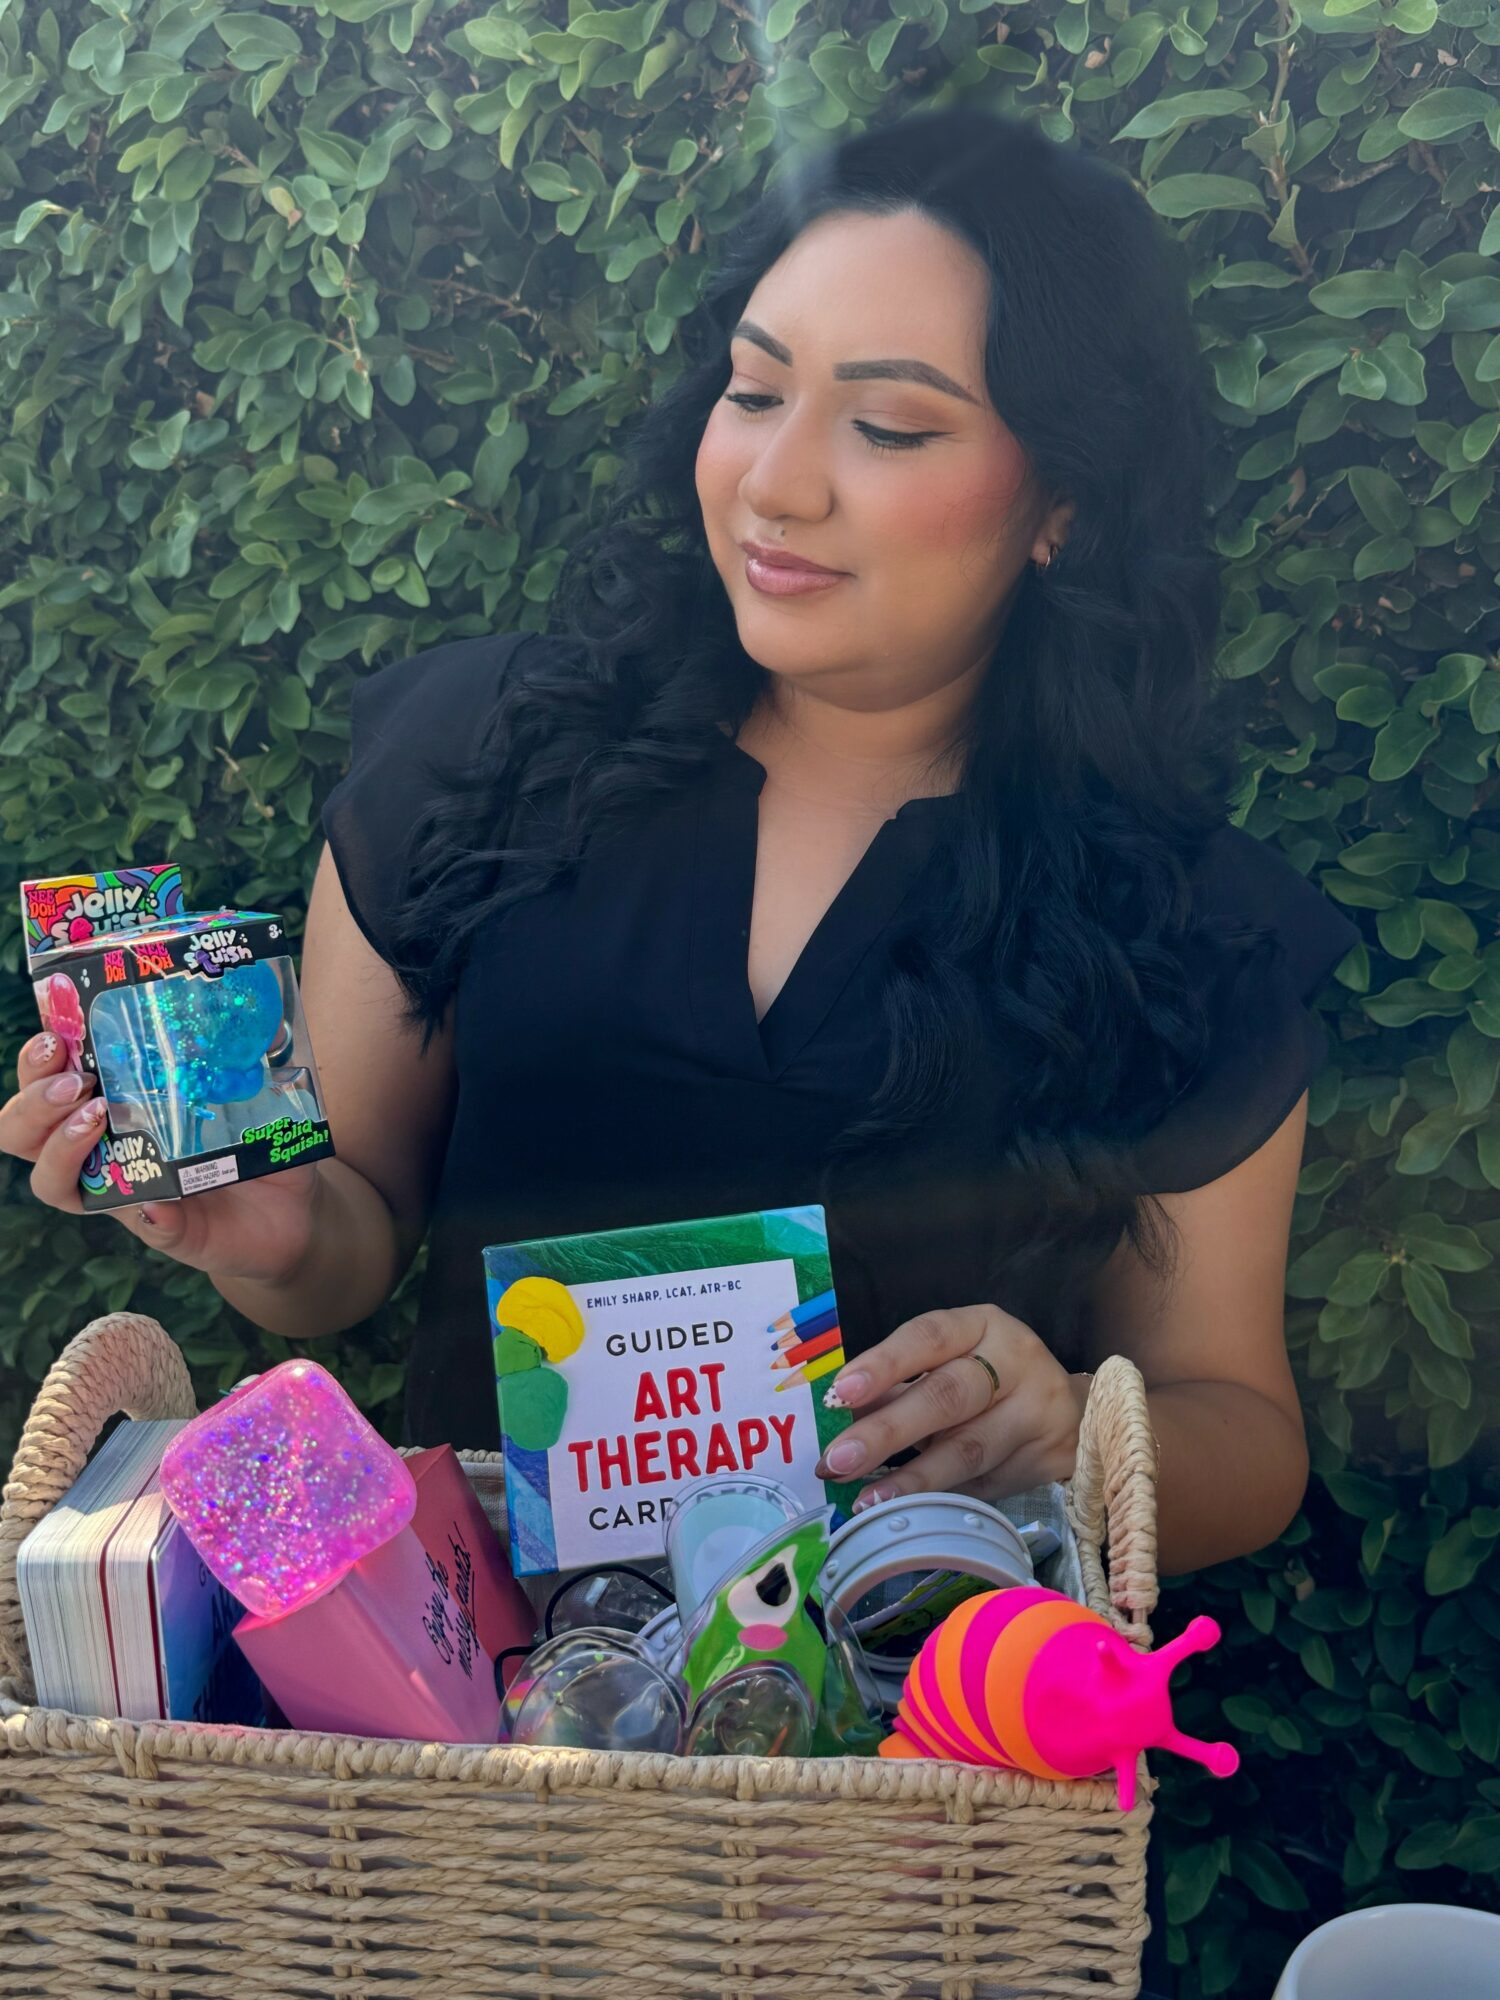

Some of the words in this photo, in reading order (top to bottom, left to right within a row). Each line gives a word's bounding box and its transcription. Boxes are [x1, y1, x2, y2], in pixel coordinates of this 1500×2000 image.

[28, 889, 55, 904] NEE
[30, 902, 56, 918] DOH
[65, 885, 143, 920] Jelly
[188, 928, 237, 951] Jelly
[104, 949, 124, 967] NEE
[105, 964, 127, 984] DOH
[244, 1117, 291, 1144] Super
[272, 1119, 313, 1147] Solid
[269, 1129, 329, 1163] Squish!
[586, 1295, 618, 1309] EMILY
[700, 1280, 743, 1295] ATR-BC
[605, 1320, 734, 1357] GUIDED
[633, 1362, 726, 1423] ART
[567, 1413, 796, 1493] THERAPY
